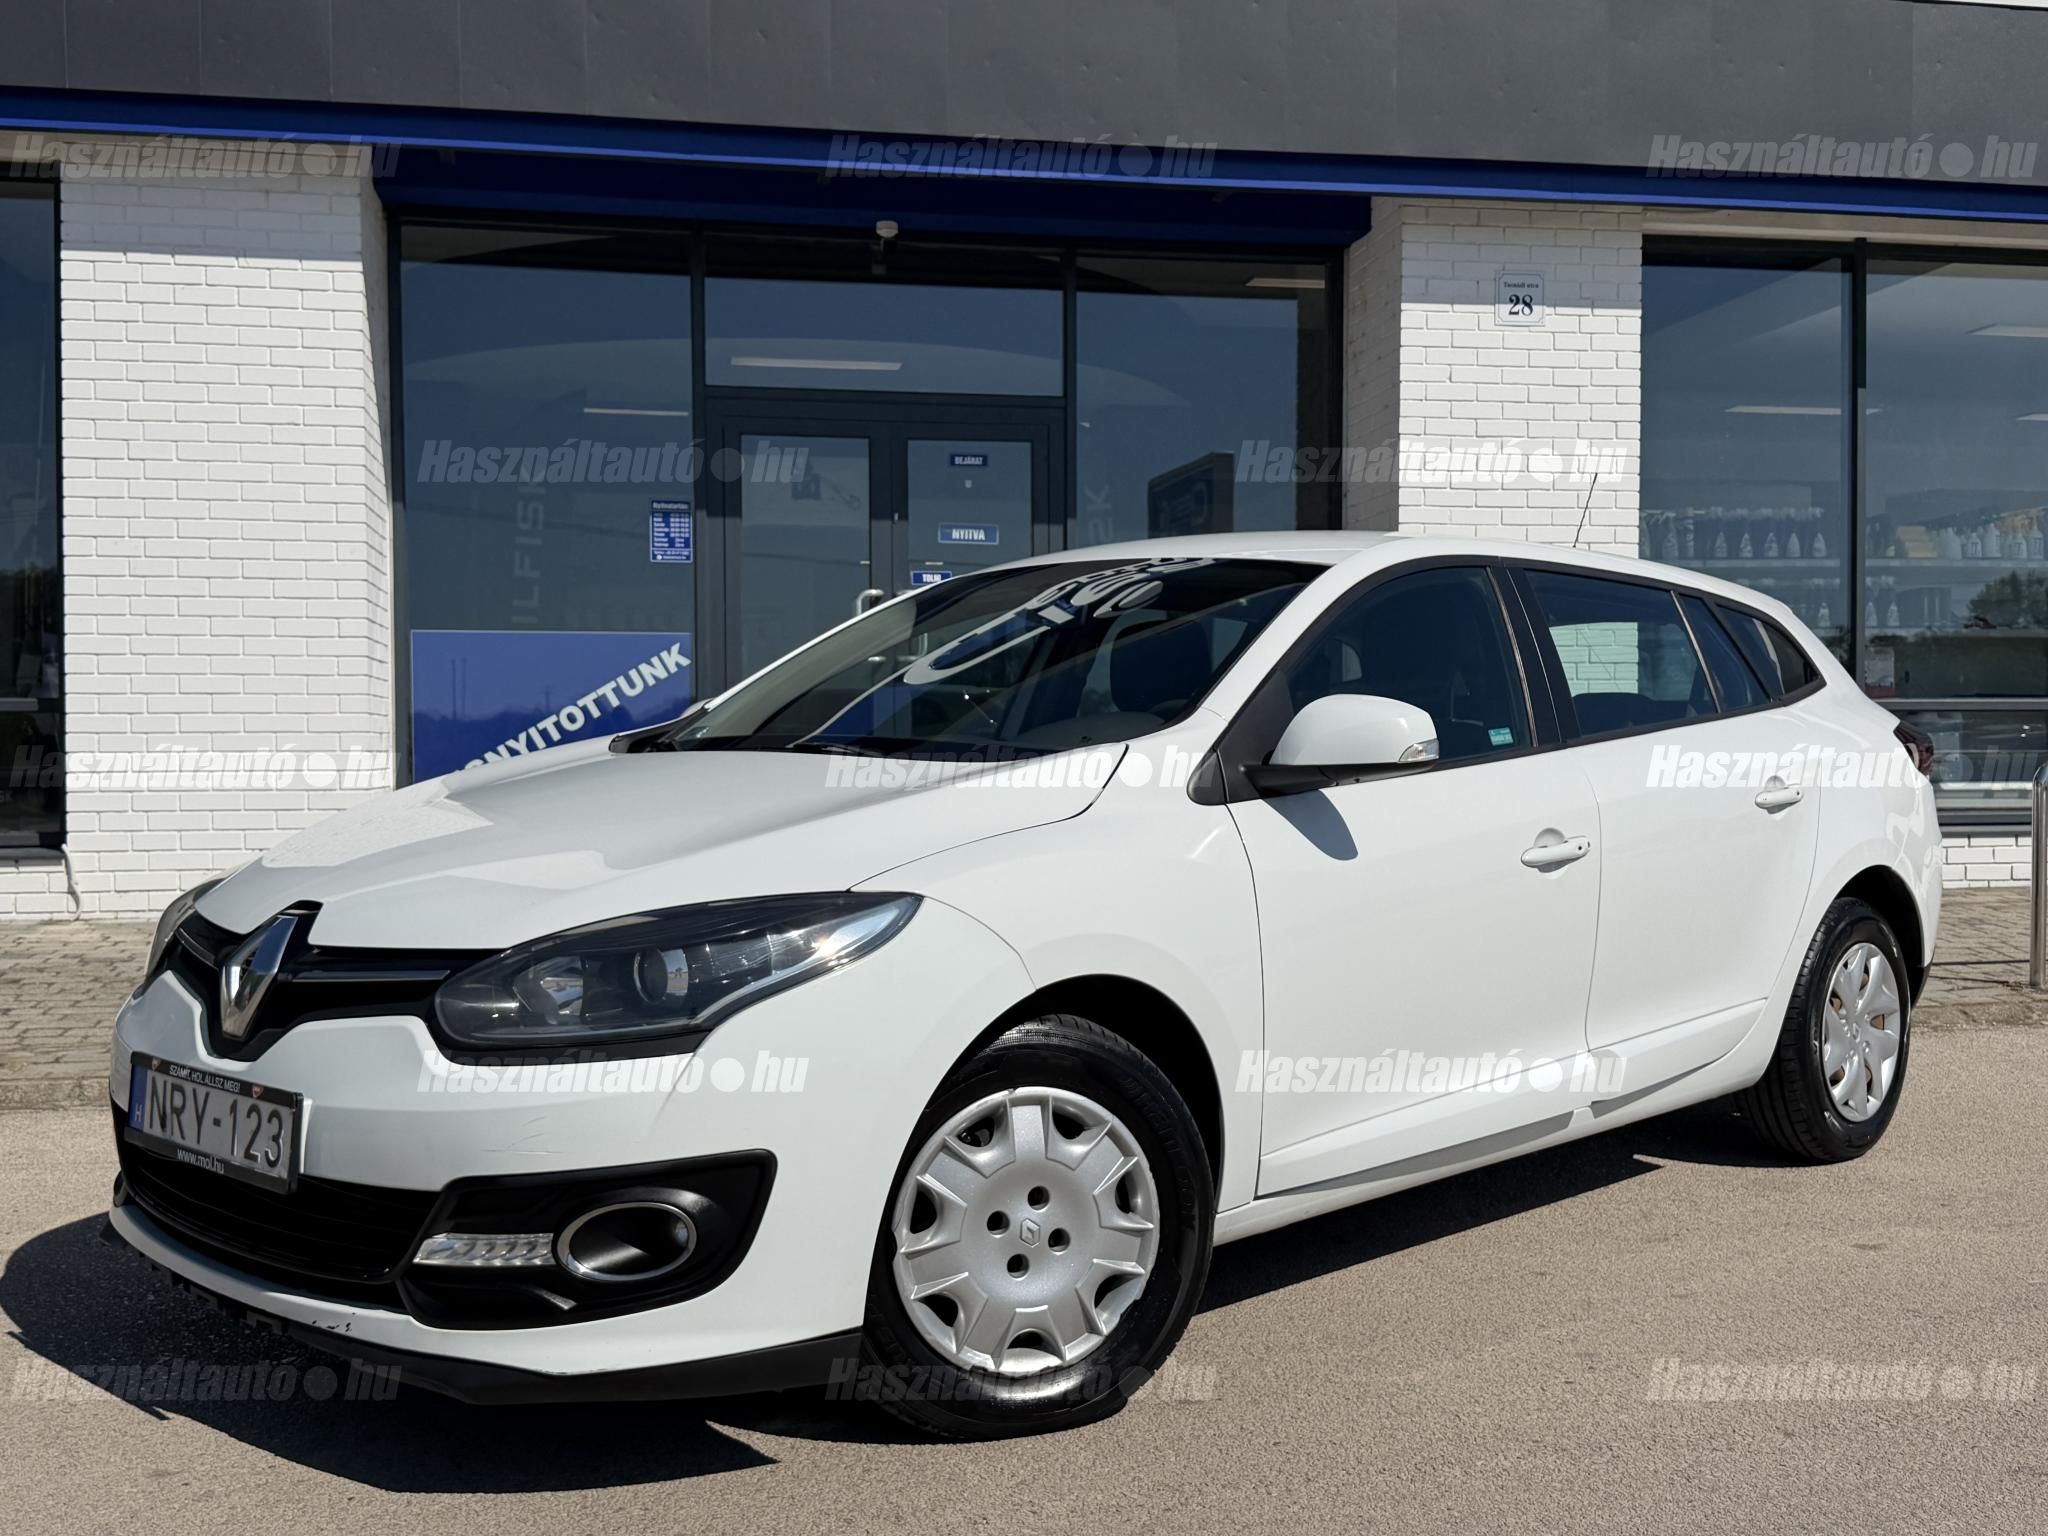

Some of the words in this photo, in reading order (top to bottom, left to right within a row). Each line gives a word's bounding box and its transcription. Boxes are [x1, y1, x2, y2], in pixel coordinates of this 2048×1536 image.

[1508, 293, 1534, 316] 28
[510, 464, 547, 625] ILFISK
[951, 528, 985, 540] NYITVA
[457, 642, 692, 773] NYITOTTUNK
[134, 1104, 143, 1122] H
[149, 1075, 285, 1168] NRY-123
[176, 1149, 225, 1175] www.mol.hu
